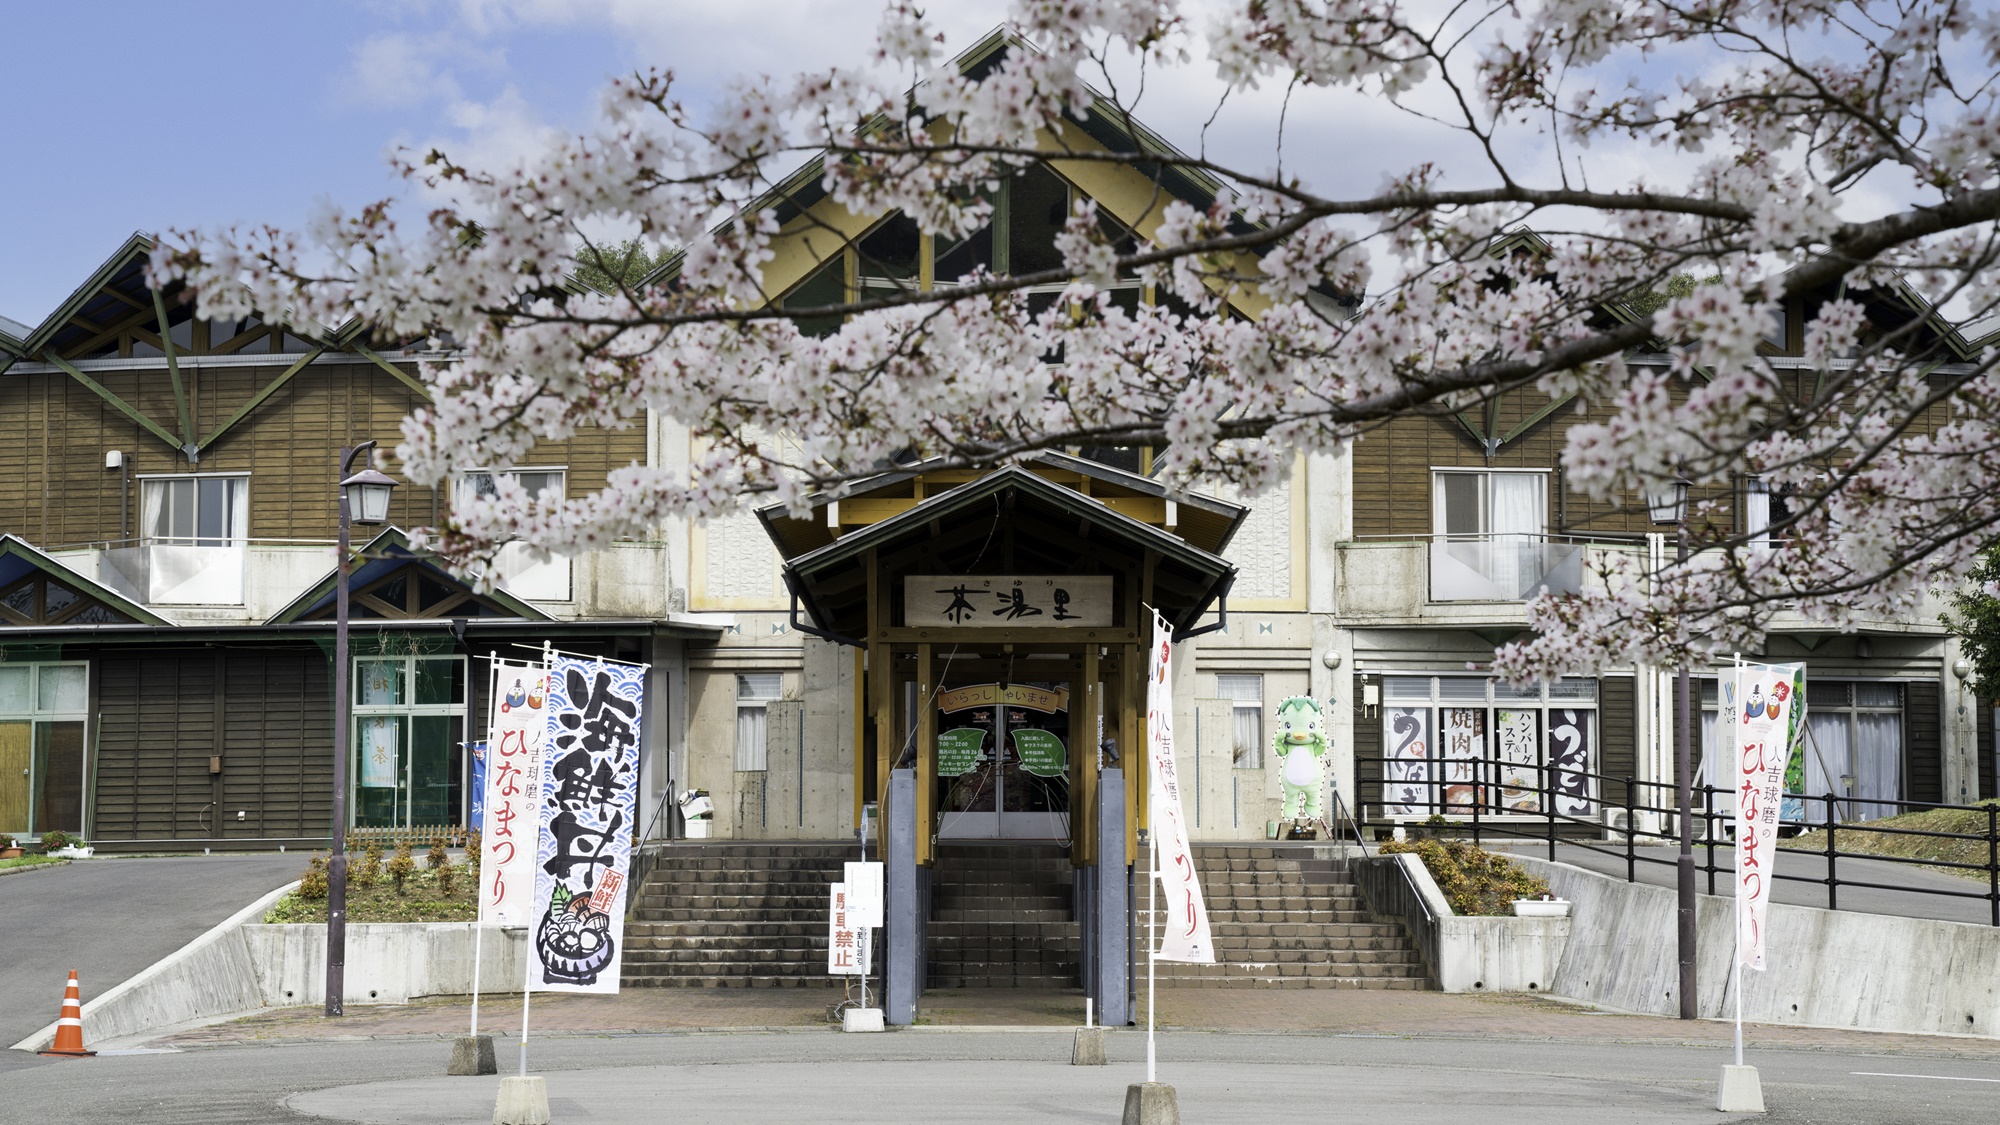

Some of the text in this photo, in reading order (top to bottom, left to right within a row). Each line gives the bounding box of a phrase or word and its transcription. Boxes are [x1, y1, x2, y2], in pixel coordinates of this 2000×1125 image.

[935, 584, 1082, 625] 茶湯里
[947, 690, 1049, 706] いらっしゃいませ
[1450, 709, 1473, 780] 焼肉丼
[1504, 727, 1517, 776] ステーキ
[1519, 713, 1533, 765] ハンバーグ
[1554, 709, 1588, 815] うどん
[543, 668, 637, 890] 海鮮丼
[1761, 745, 1782, 838] 人吉球磨の
[491, 730, 527, 906] ひなまつり
[1741, 743, 1766, 948] ひなまつり
[591, 871, 621, 909] 新鮮
